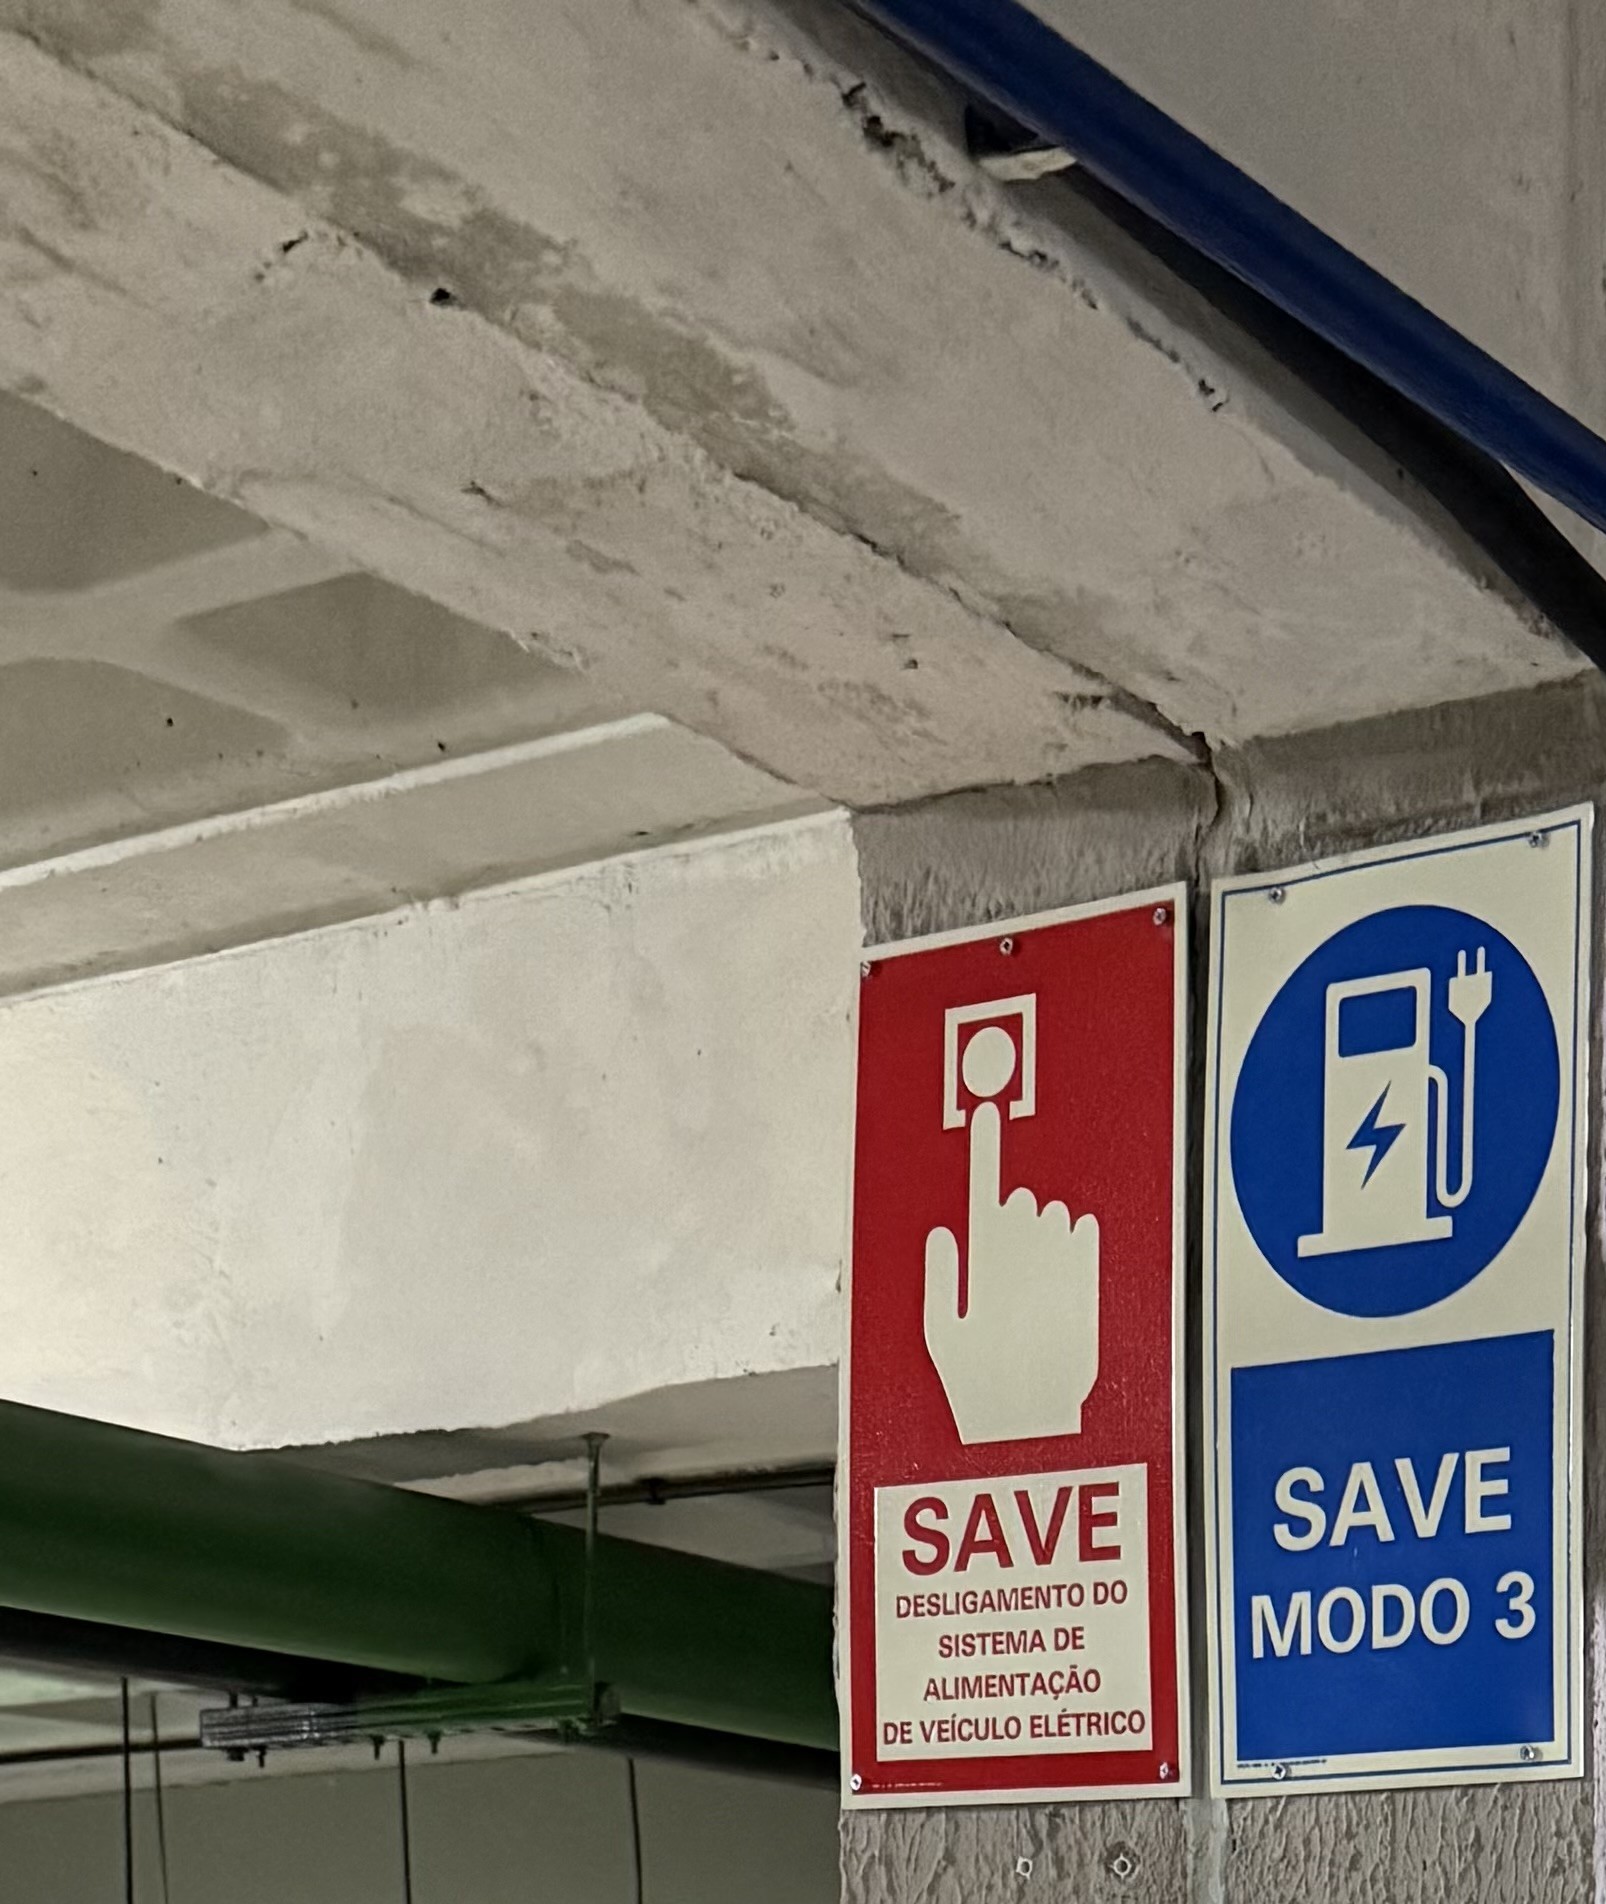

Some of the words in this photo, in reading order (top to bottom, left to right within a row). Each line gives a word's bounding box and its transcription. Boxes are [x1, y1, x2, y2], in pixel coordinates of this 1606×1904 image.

[1273, 1446, 1512, 1551] SAVE
[902, 1481, 1122, 1576] SAVE
[896, 1582, 1085, 1619] DESLIGAMENTO
[1093, 1579, 1128, 1605] DO
[1251, 1577, 1470, 1659] MODO
[1495, 1570, 1536, 1639] 3
[938, 1629, 1047, 1659] SISTEMA
[1054, 1626, 1085, 1652] DE
[923, 1664, 1101, 1702] ALIMENTAÇÃO
[883, 1721, 913, 1745] DE
[919, 1713, 1022, 1743] VEÍCULO
[1029, 1708, 1146, 1739] ELÉTRICO
